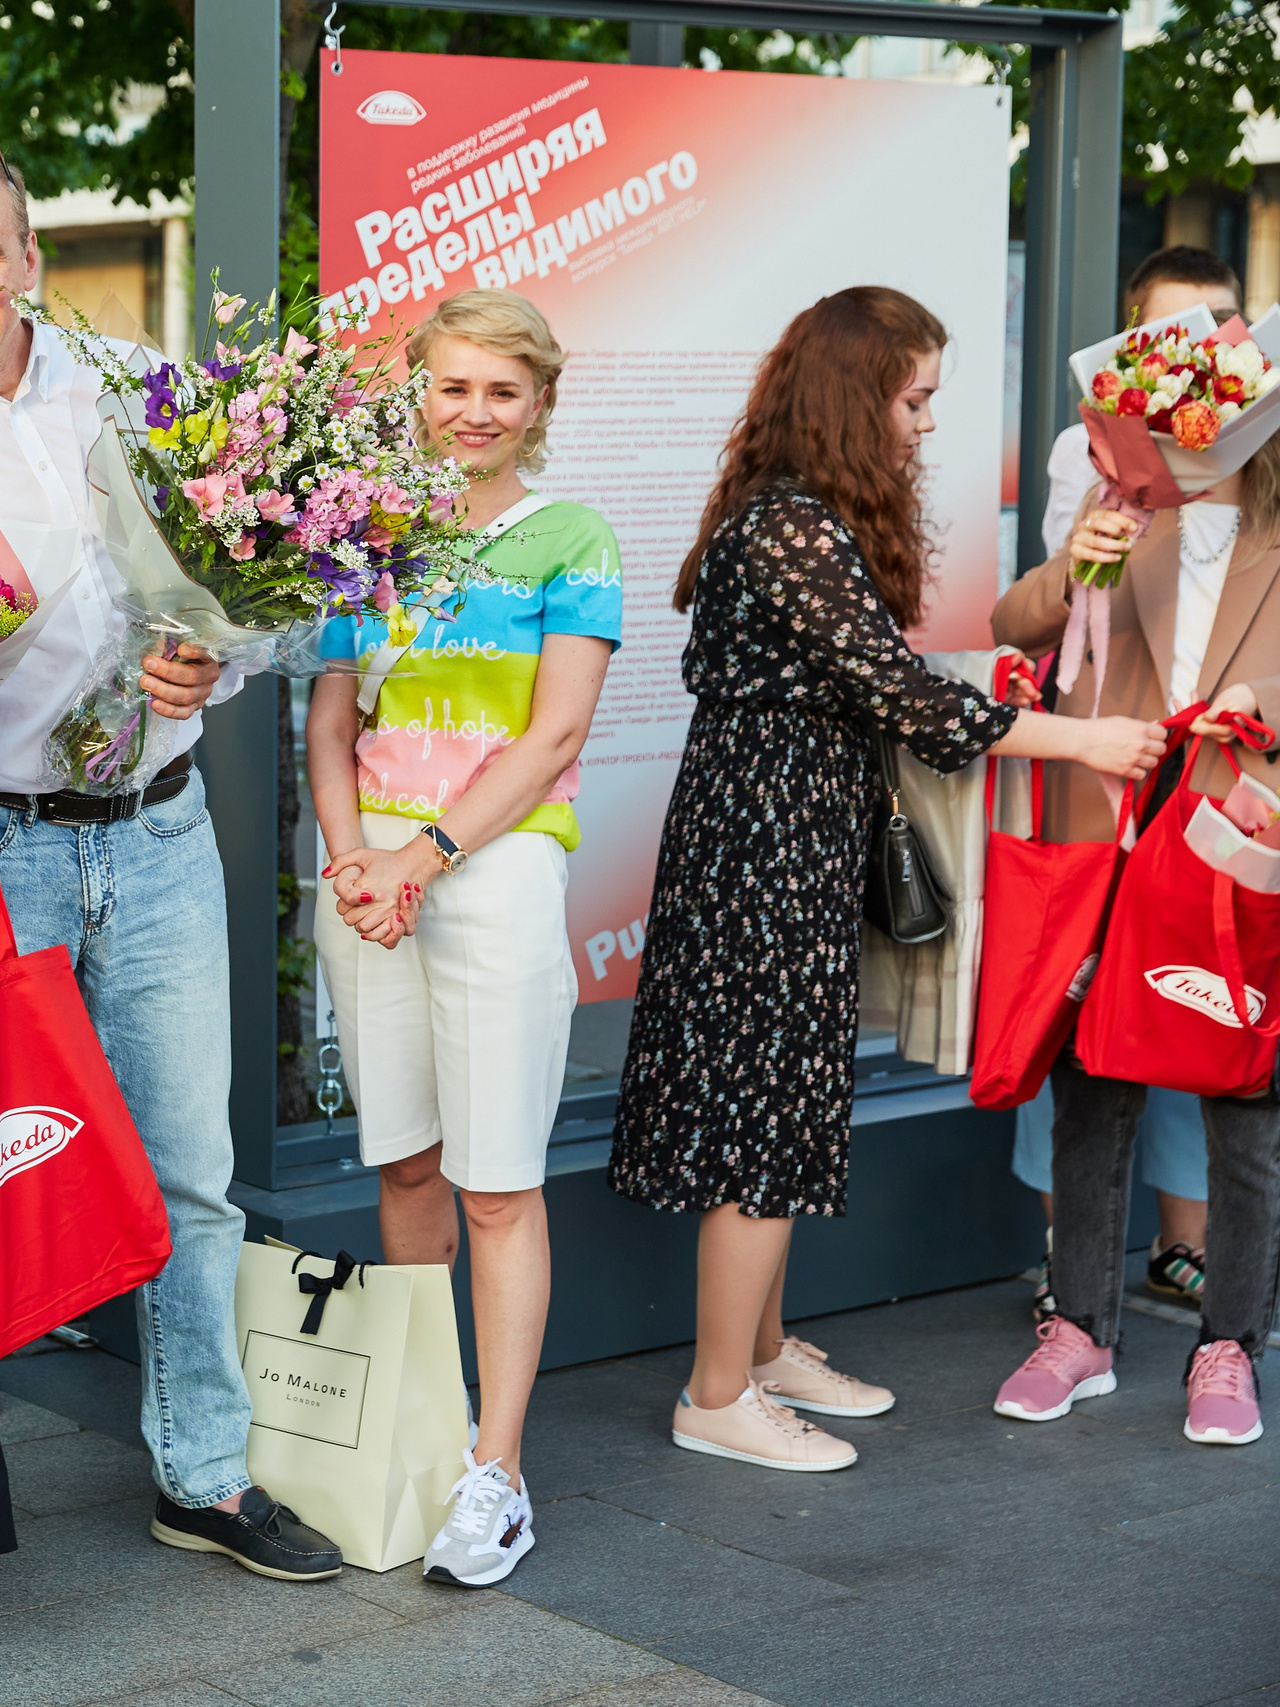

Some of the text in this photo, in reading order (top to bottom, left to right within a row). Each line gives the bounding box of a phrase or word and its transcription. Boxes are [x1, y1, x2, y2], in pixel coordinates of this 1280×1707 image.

[373, 103, 413, 115] Takeda
[406, 76, 590, 180] в поддержку развития медицины
[355, 107, 607, 269] Расширяя
[410, 122, 527, 196] редких заболеваний
[472, 150, 698, 289] видимого
[319, 194, 537, 338] пределы
[432, 623, 506, 661] love
[405, 697, 516, 764] of hope
